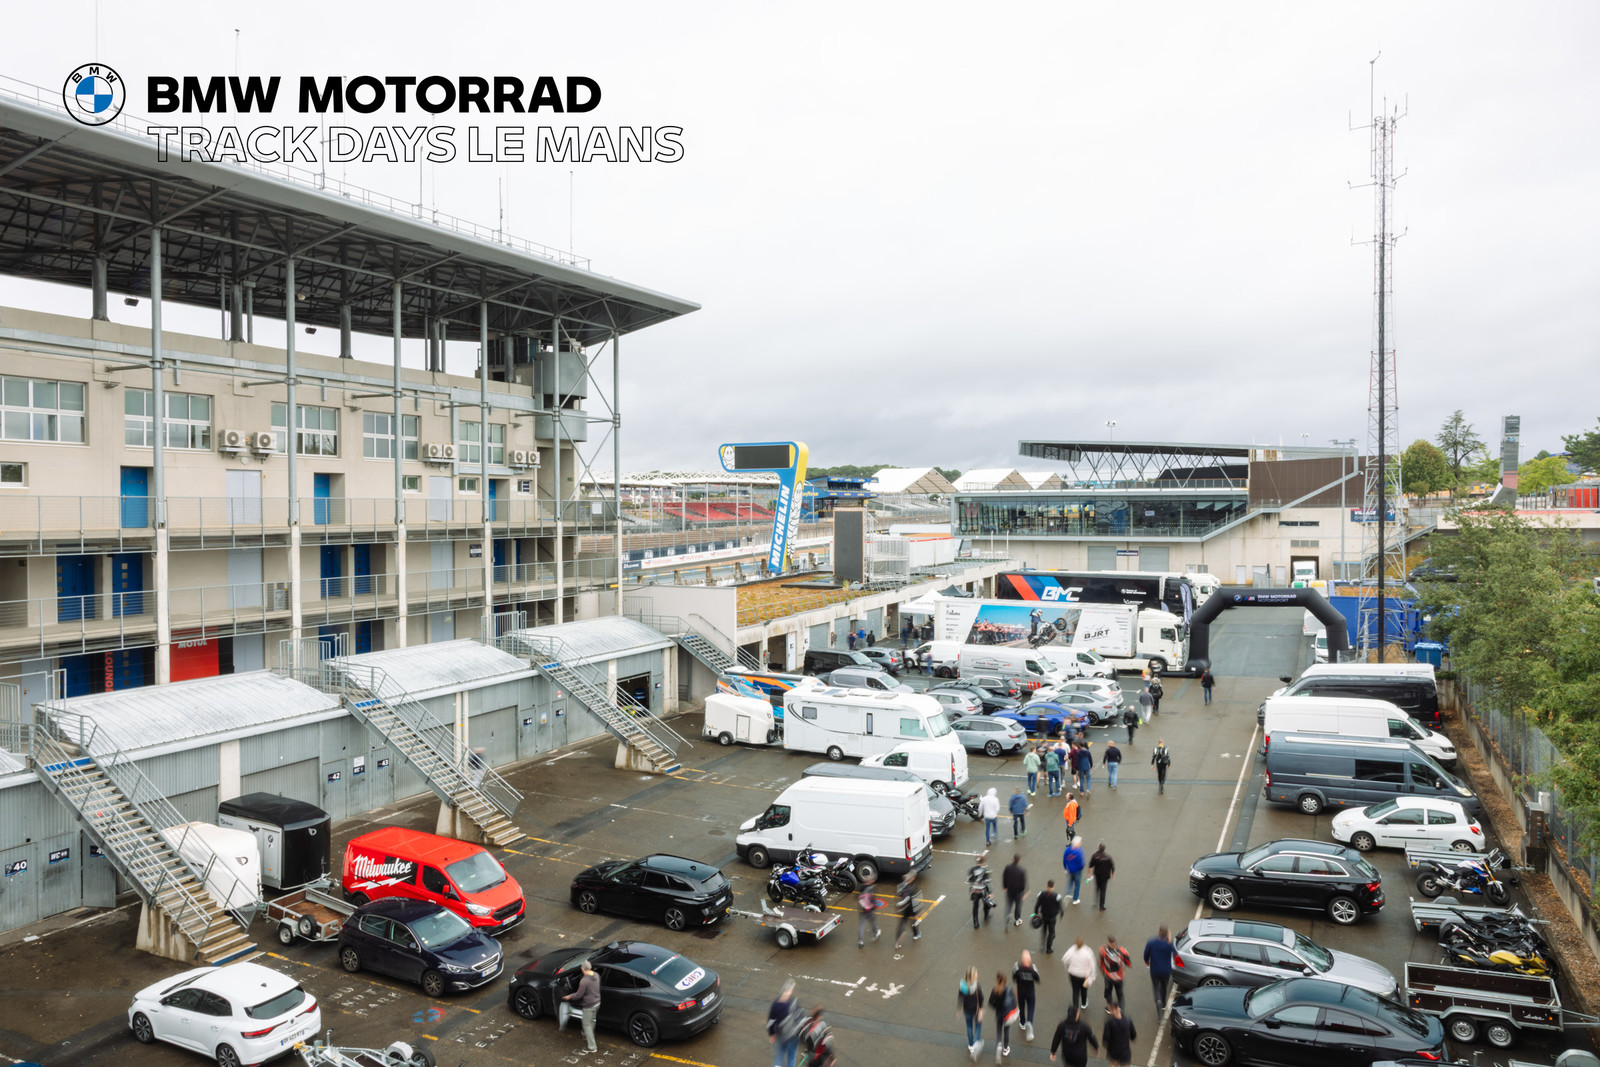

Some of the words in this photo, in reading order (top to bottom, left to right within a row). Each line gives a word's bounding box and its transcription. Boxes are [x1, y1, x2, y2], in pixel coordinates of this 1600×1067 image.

[770, 484, 790, 568] MICHELIN
[1083, 629, 1110, 639] BJRT
[178, 640, 208, 648] MOTUL
[105, 652, 114, 692] LOUNGE
[50, 852, 60, 860] WC
[13, 861, 27, 871] 40
[352, 854, 411, 880] Milwaukee
